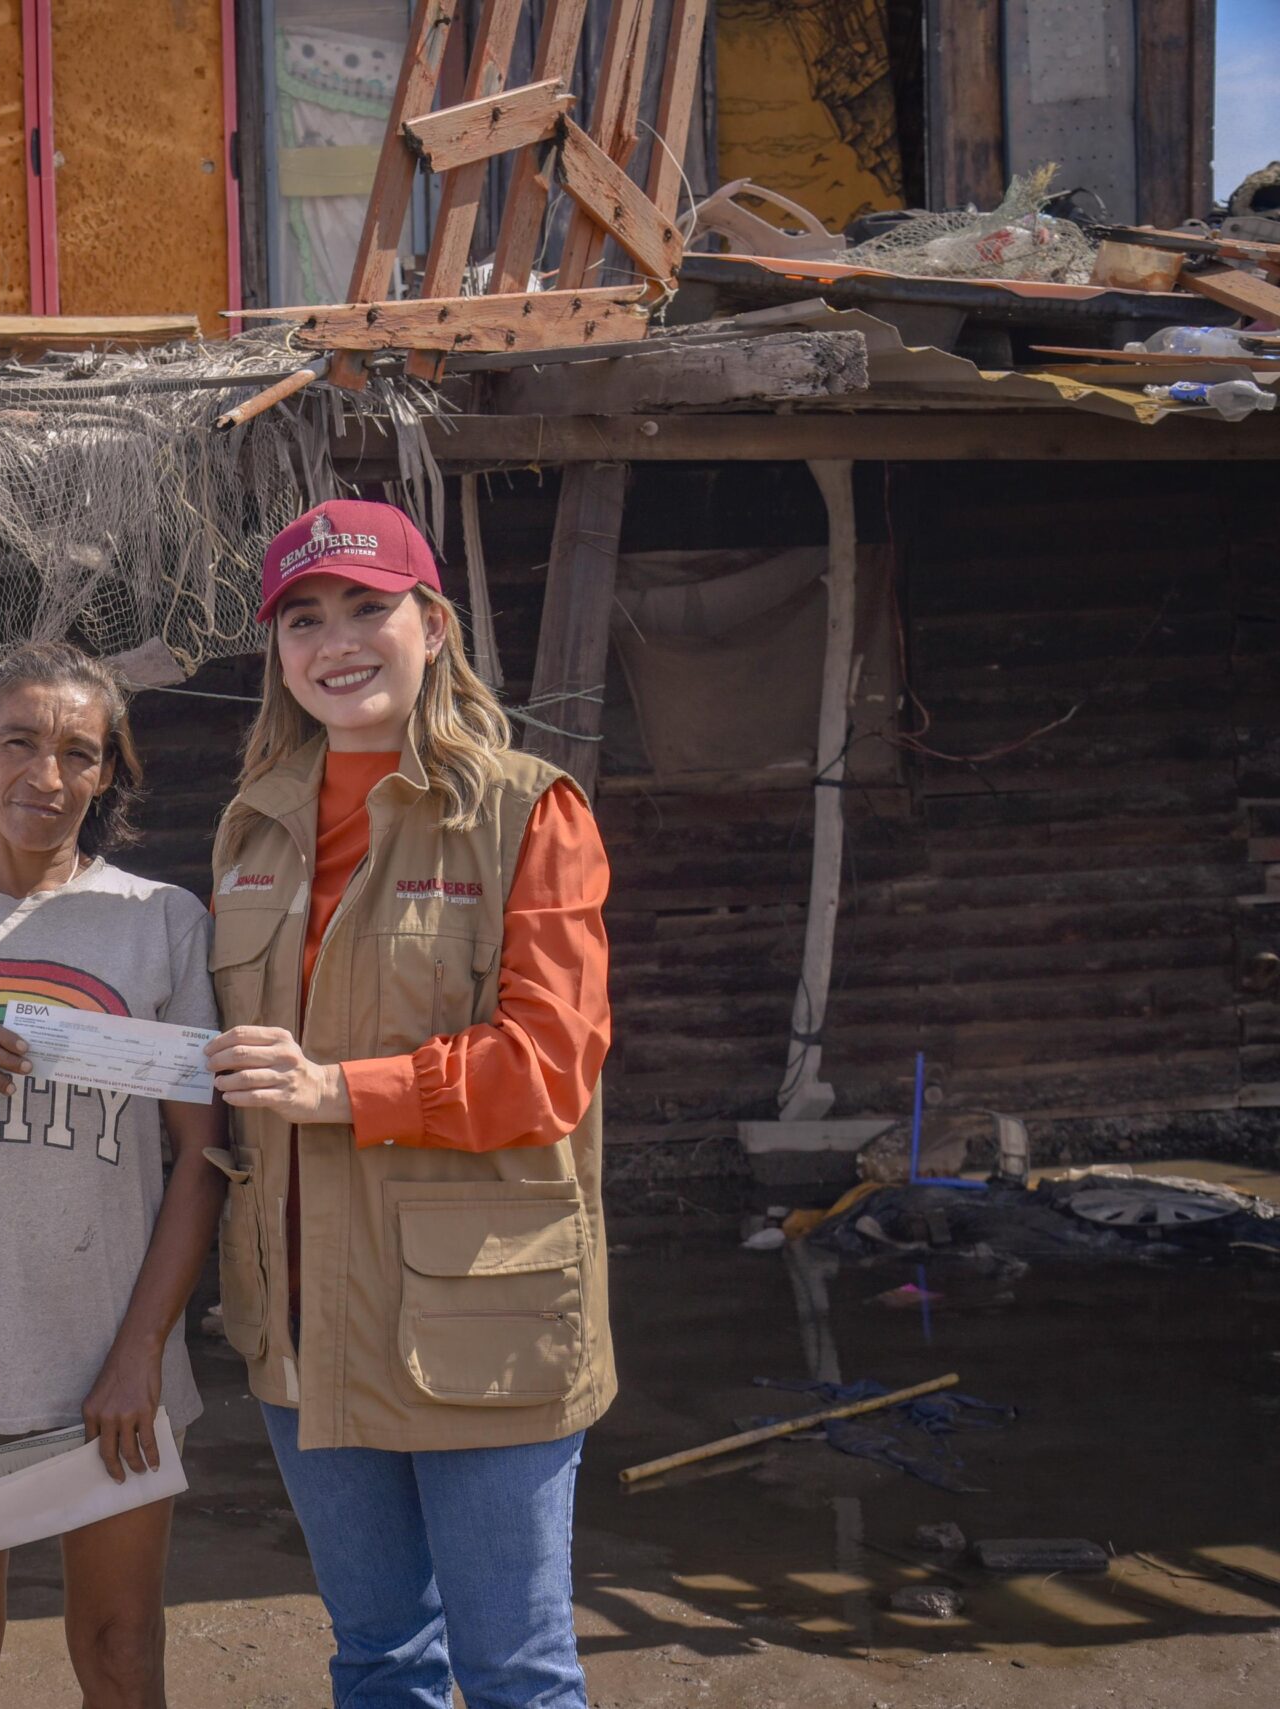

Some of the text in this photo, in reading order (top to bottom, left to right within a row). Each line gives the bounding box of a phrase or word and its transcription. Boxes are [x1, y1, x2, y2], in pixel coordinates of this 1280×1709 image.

[280, 533, 379, 572] SEMUJERES
[344, 548, 377, 556] MUJERES
[396, 877, 483, 897] SEMUERES
[16, 1003, 50, 1017] BBVA
